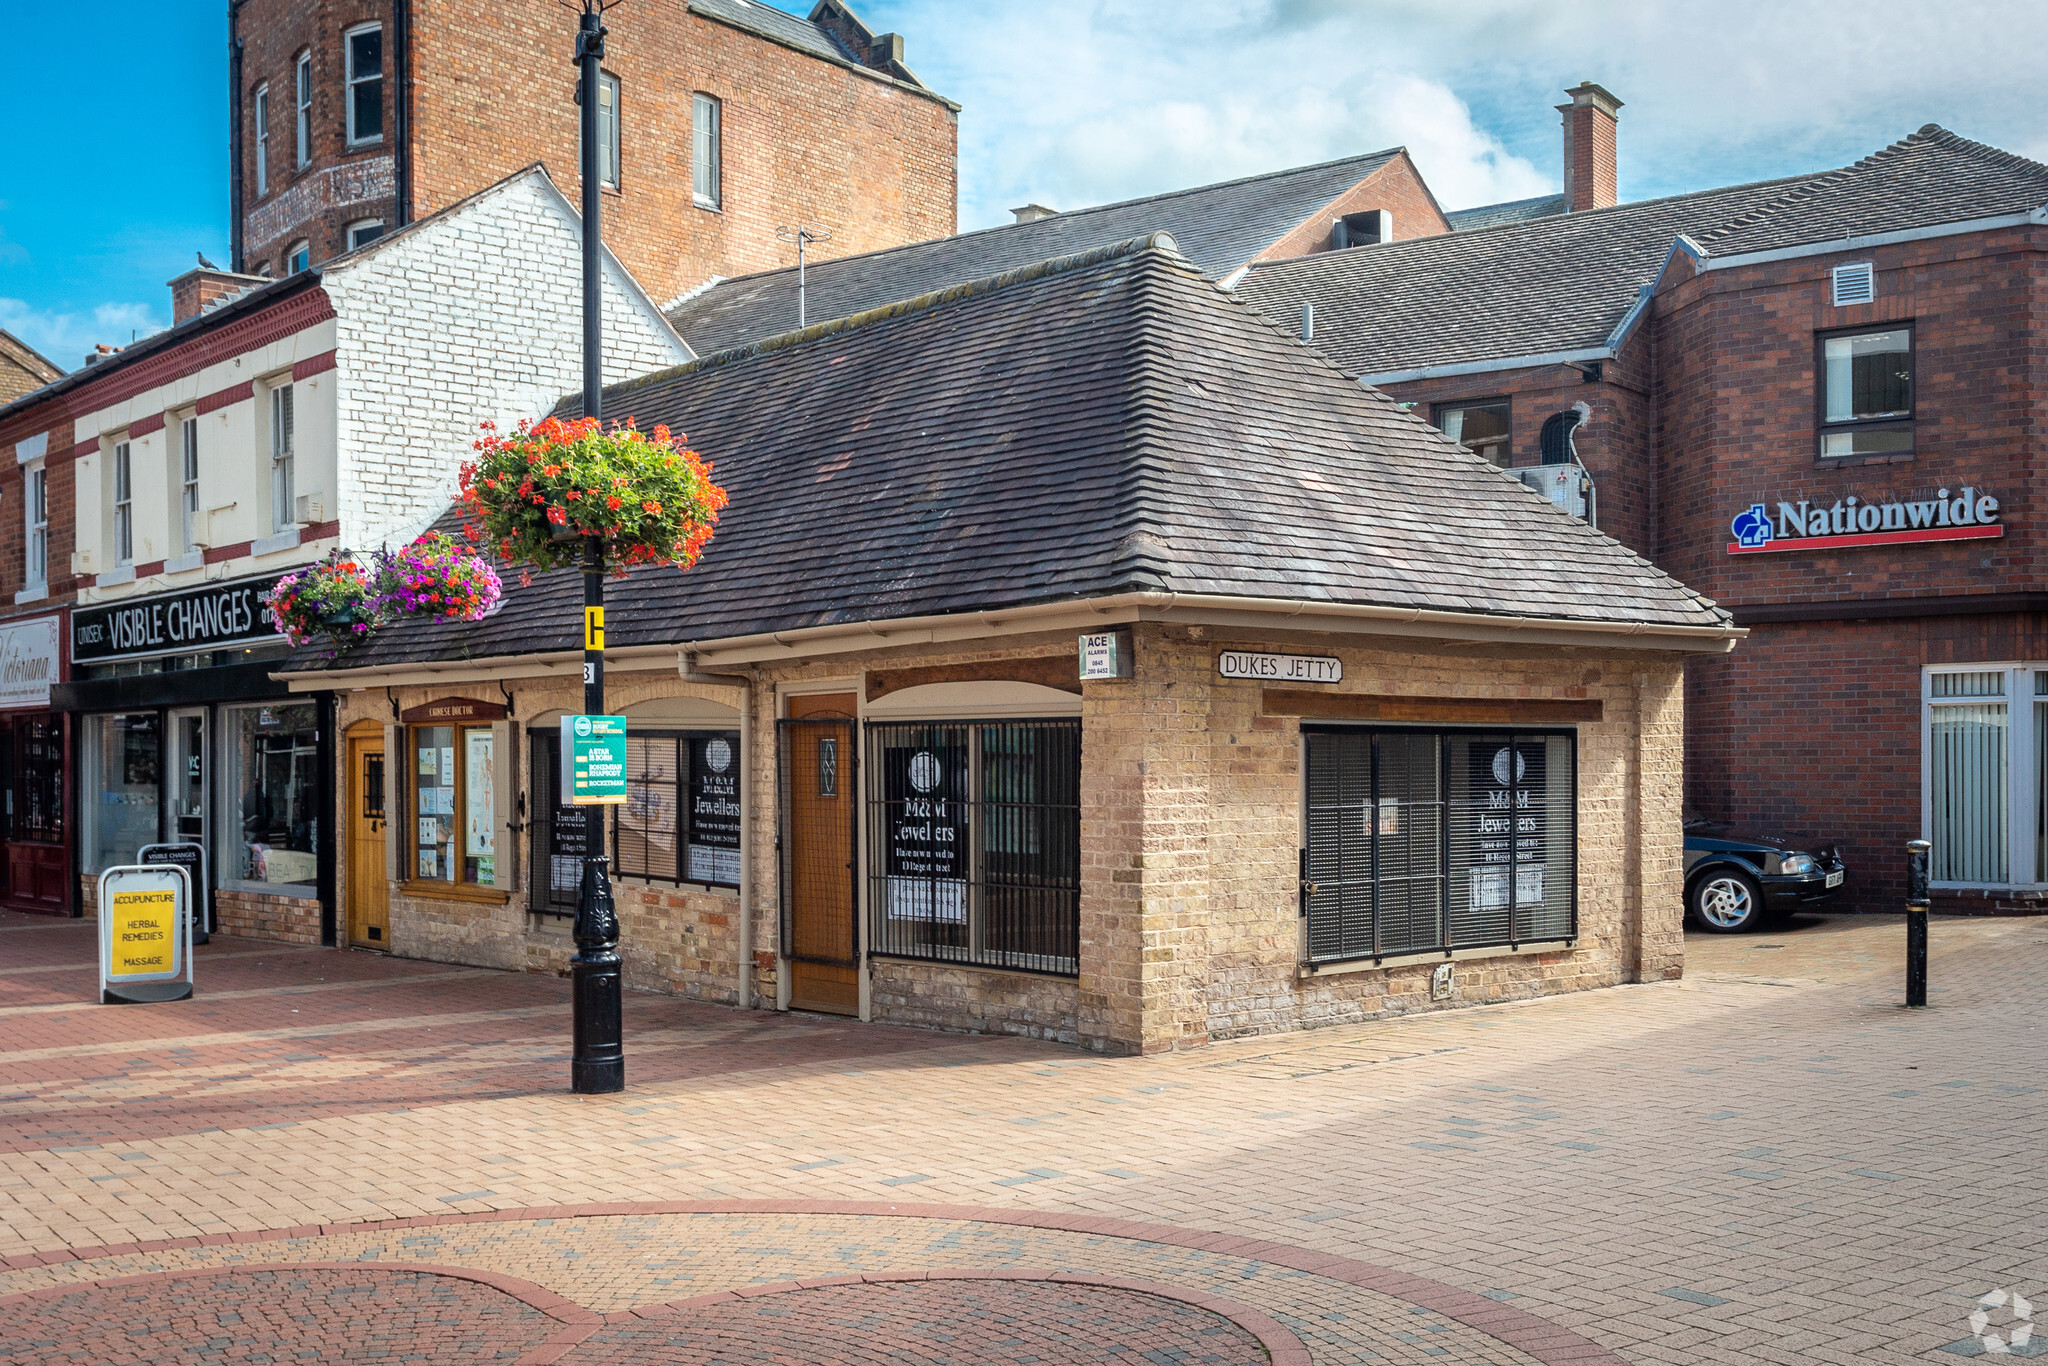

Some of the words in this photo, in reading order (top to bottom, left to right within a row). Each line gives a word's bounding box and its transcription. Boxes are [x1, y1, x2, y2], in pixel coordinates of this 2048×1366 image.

[1777, 486, 1999, 538] Nationwide
[77, 624, 104, 645] UNISEX
[108, 605, 164, 649] VISIBLE
[168, 589, 252, 641] CHANGES
[1087, 636, 1108, 648] ACE
[1225, 655, 1277, 676] DUKES
[1286, 658, 1337, 679] JETTY
[429, 706, 451, 717] CHINESE
[451, 705, 474, 716] DOCTOR
[694, 796, 740, 816] Jewellers
[1365, 820, 1398, 833] SLE
[1478, 814, 1537, 833] Jeweers
[895, 820, 955, 842] ewelers
[169, 851, 196, 859] CHANGES
[113, 893, 175, 905] ACCUPUNCTURE
[127, 920, 160, 929] HERBAL
[122, 931, 164, 942] REMEDIES
[124, 956, 163, 966] MASSAGE
